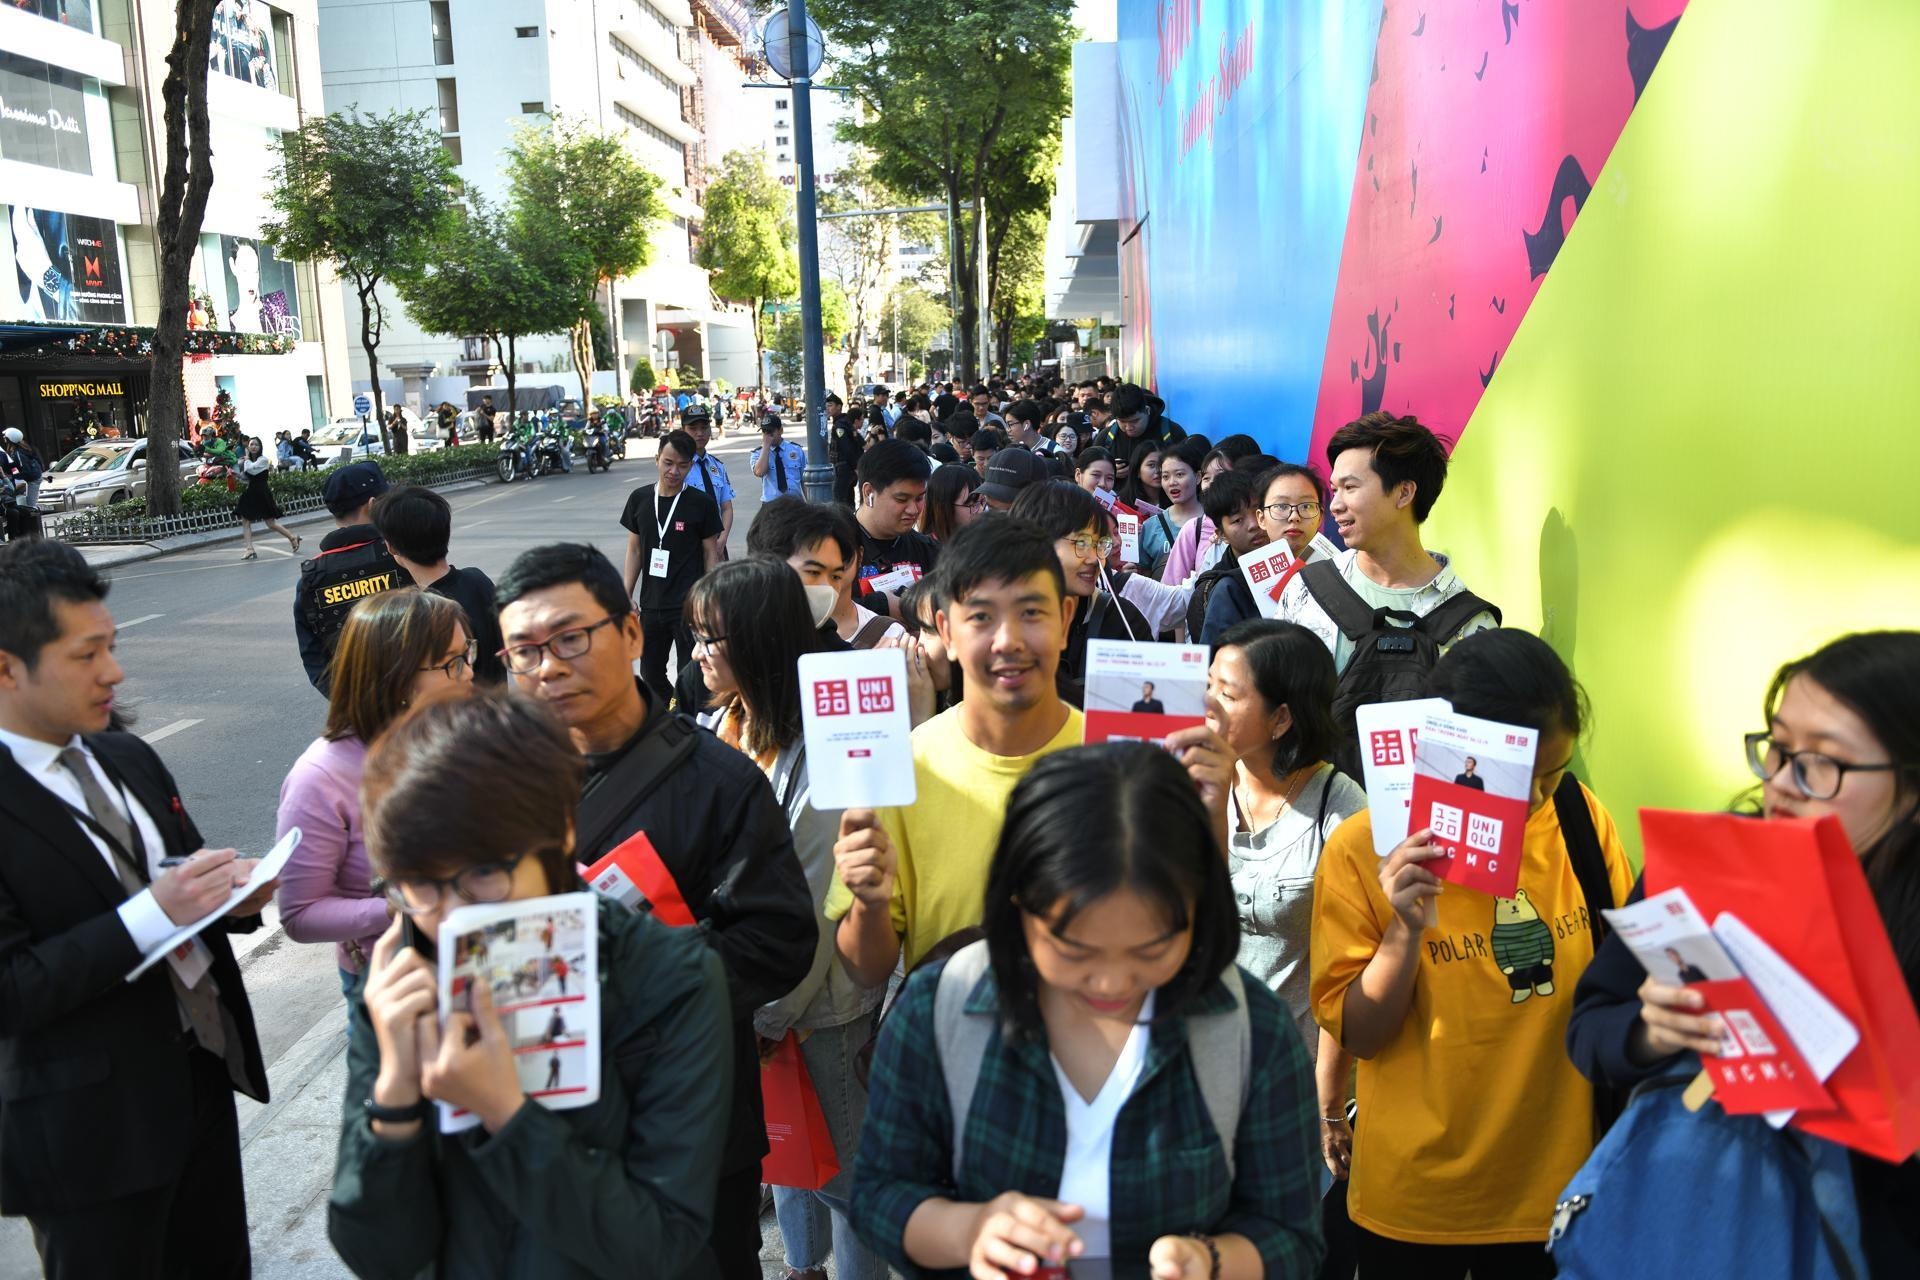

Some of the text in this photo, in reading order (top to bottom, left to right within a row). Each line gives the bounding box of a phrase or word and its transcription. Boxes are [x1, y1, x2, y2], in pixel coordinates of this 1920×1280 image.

[1178, 20, 1254, 165] Coming Soon
[47, 108, 81, 134] Dutti
[40, 382, 124, 397] SHOPPING MALL
[1271, 554, 1285, 565] UNI
[1274, 561, 1289, 572] QLO
[324, 573, 390, 604] SECURITY
[860, 680, 888, 695] UNI
[861, 695, 892, 712] QLO
[1472, 818, 1495, 834] UNI
[1470, 832, 1496, 848] QLO
[1427, 933, 1488, 965] POLAR
[1555, 906, 1591, 940] BEAR
